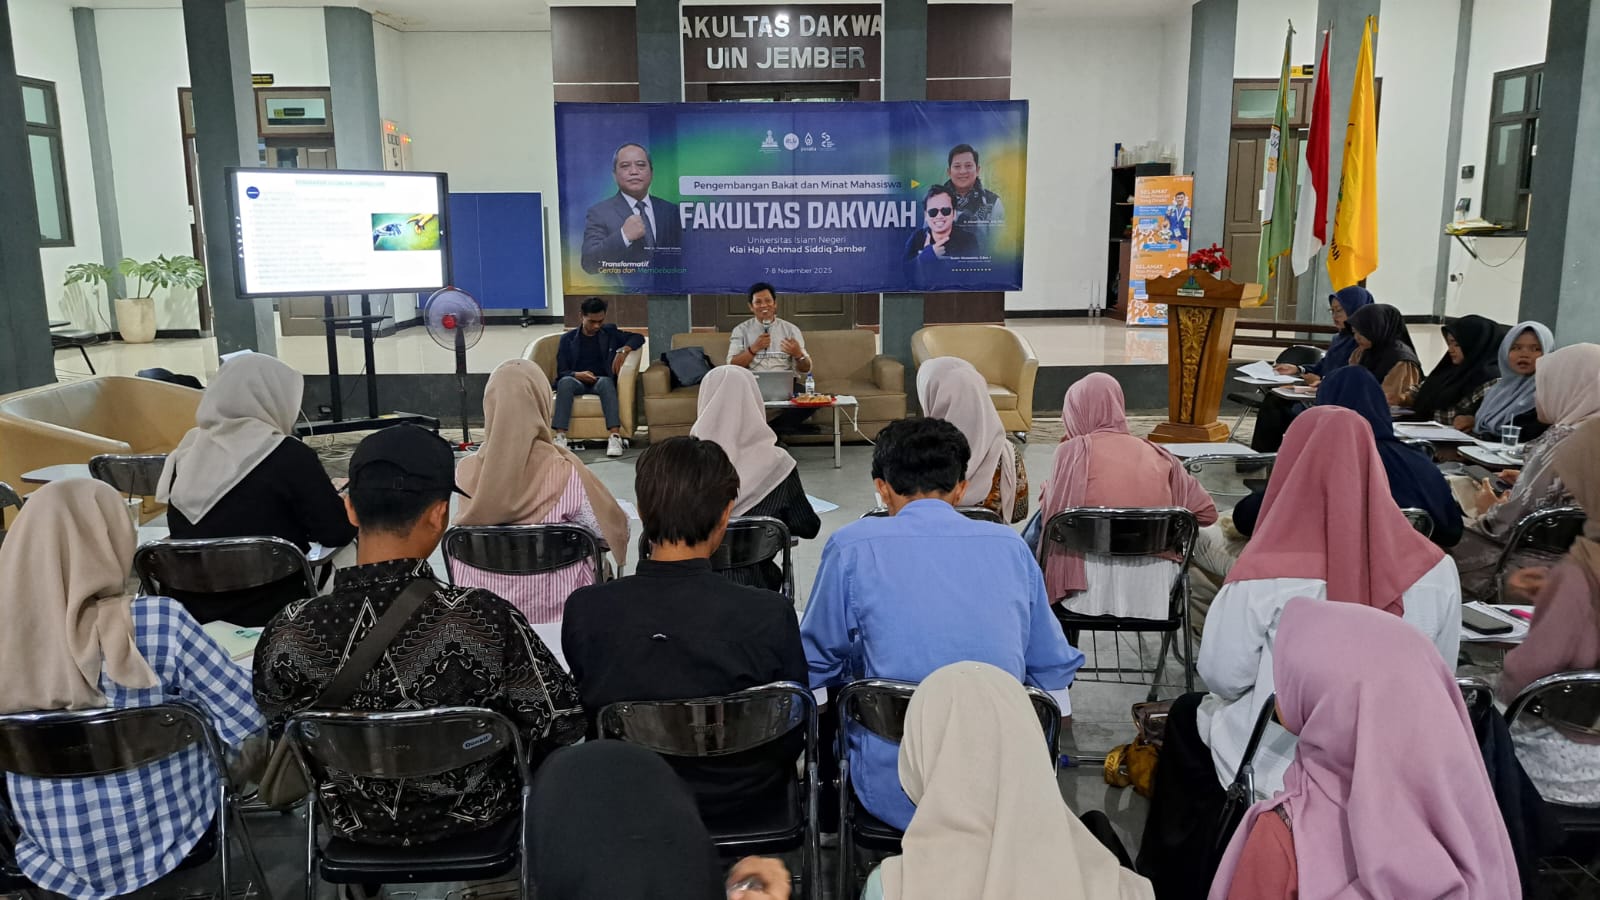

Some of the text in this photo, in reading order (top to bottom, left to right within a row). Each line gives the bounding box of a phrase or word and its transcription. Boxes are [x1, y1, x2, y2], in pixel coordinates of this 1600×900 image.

[682, 14, 881, 38] AKULTAS DAKWA
[707, 46, 866, 69] UIN JEMBER
[694, 180, 902, 191] Pengembangan Bakat dan Minat Mahasiswa
[680, 200, 917, 229] FAKULTAS DAKWAH
[747, 235, 846, 245] Universitas Islam Negeri
[729, 245, 867, 255] Kiai Haji Achmad Siddiq Jember
